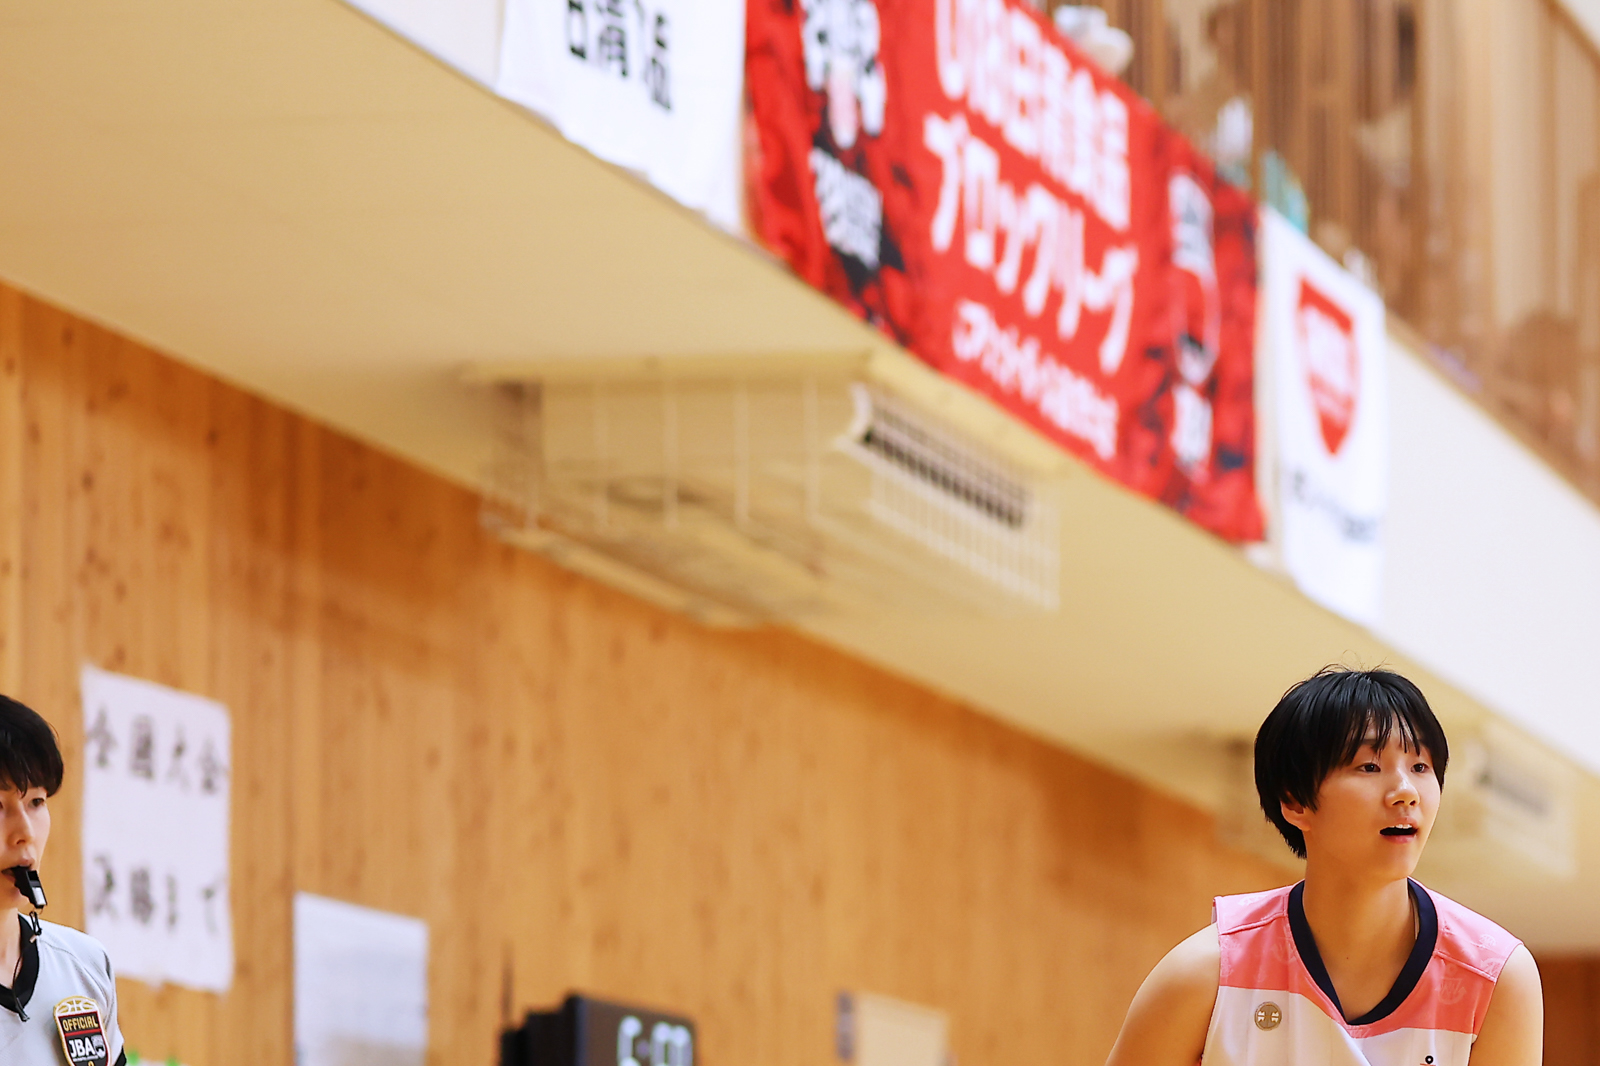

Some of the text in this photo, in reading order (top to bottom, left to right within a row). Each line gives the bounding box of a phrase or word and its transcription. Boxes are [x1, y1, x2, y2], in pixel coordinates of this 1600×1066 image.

[923, 110, 1140, 376] ブロックリーグ
[62, 1014, 99, 1032] OFFICIAL
[68, 1036, 95, 1059] JBA
